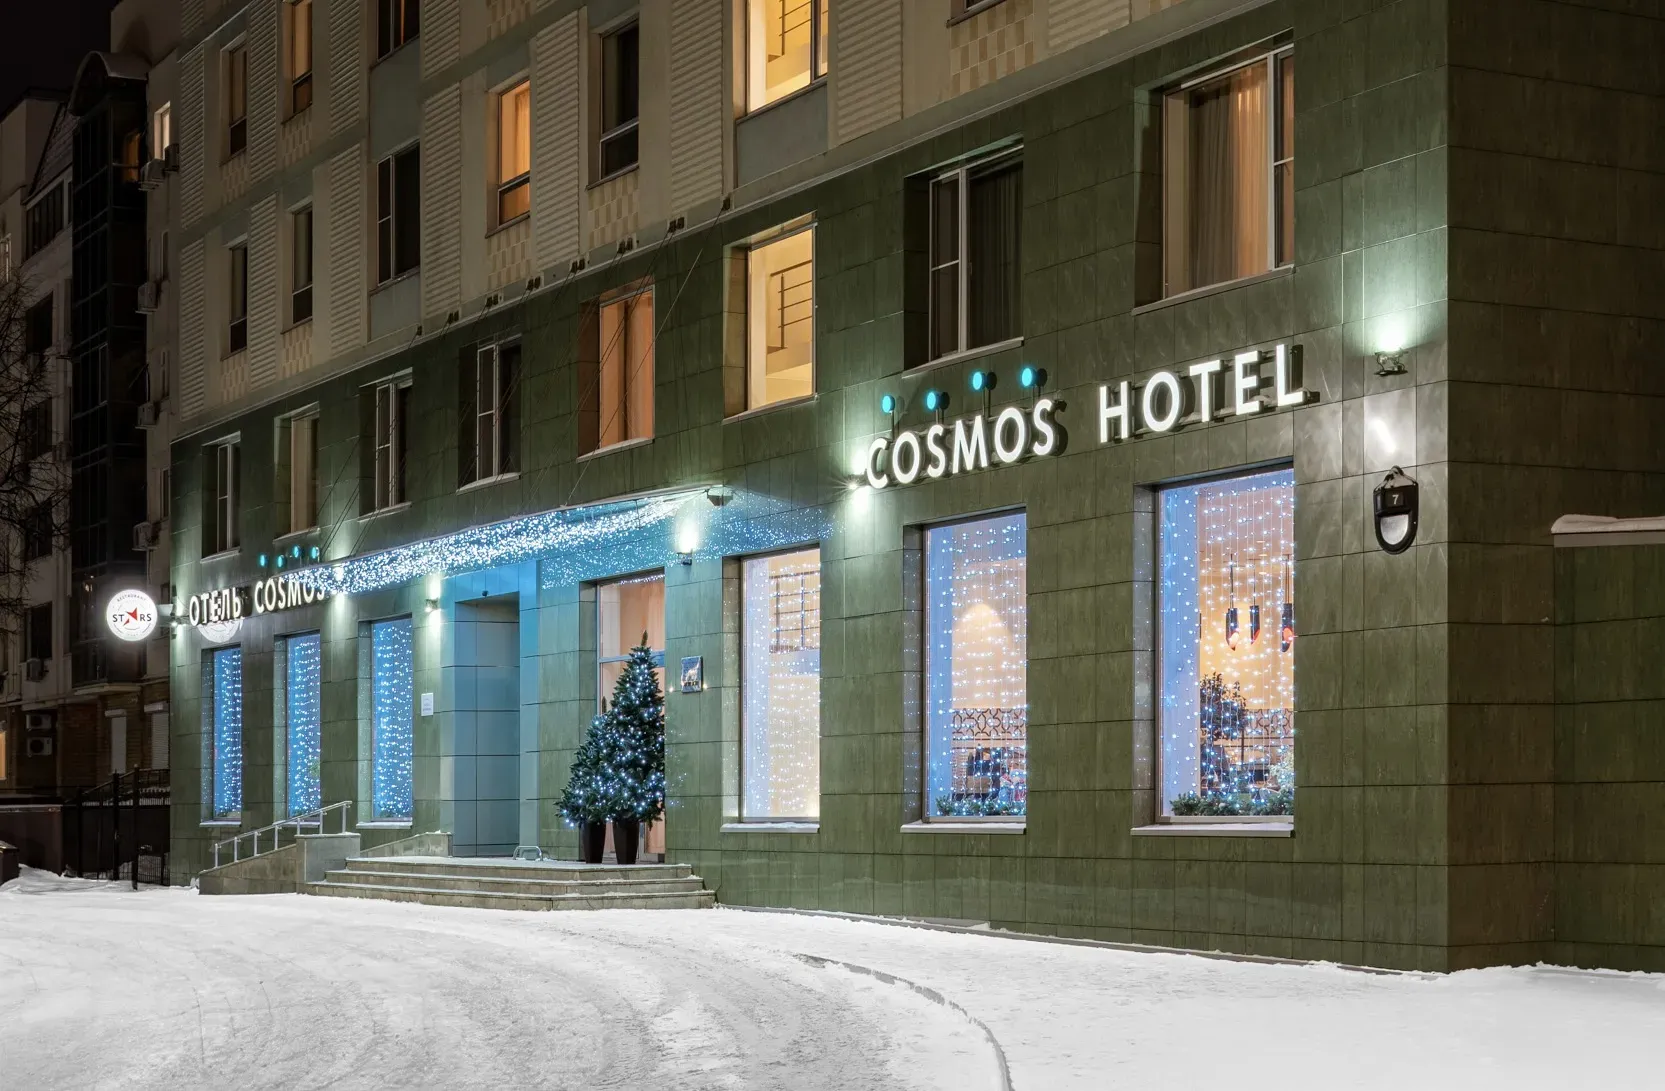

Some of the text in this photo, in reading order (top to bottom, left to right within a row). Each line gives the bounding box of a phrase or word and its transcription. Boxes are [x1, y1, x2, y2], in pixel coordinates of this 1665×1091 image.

[866, 344, 1306, 489] COSMOS HOTEL
[1391, 493, 1399, 505] 7
[188, 587, 242, 627] ОТЕЛЬ
